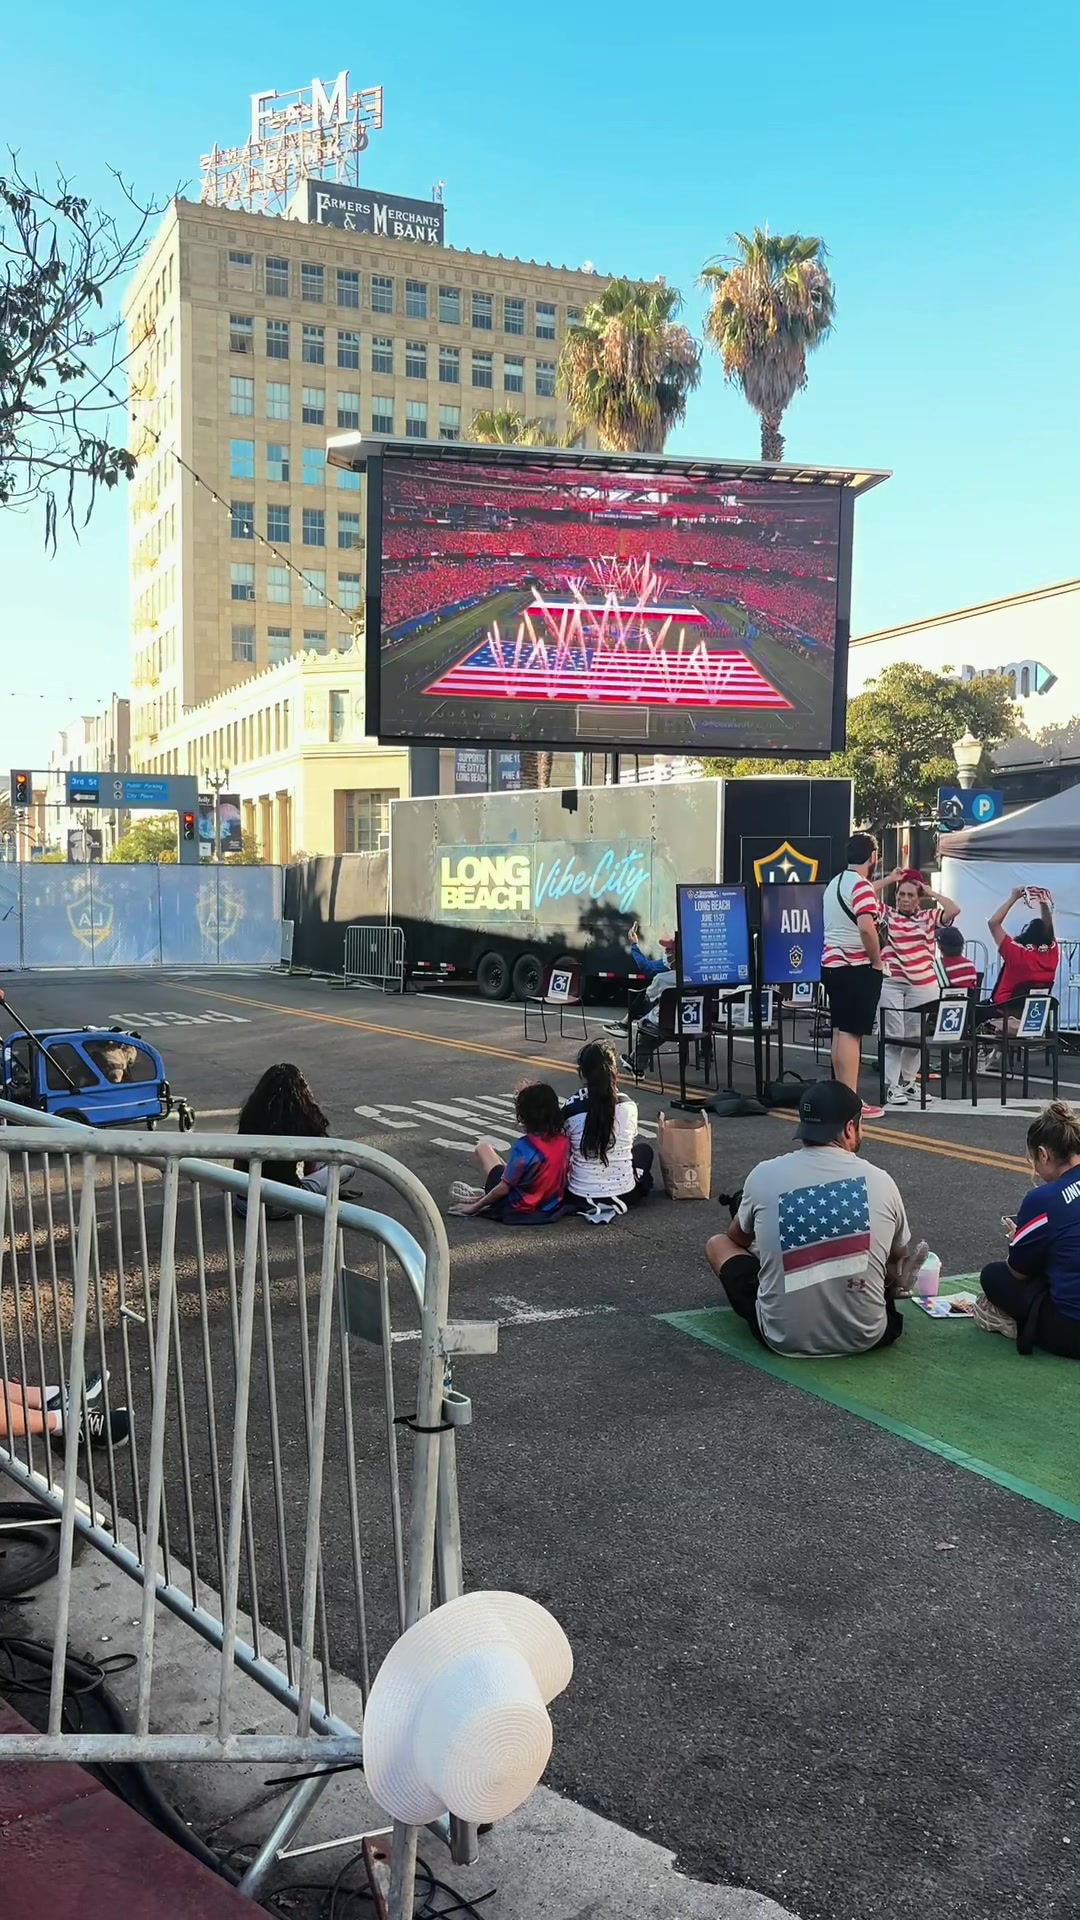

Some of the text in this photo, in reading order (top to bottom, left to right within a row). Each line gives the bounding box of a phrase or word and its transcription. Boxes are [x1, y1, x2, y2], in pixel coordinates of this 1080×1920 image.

[394, 222, 439, 243] BANK
[458, 752, 486, 763] SUPPORTS
[500, 754, 513, 763] JUNE
[456, 763, 467, 772] THE
[467, 763, 480, 772] CITY
[455, 773, 488, 783] LONG BEACH
[501, 771, 515, 780] PINE
[71, 778, 97, 786] 3rd St
[978, 798, 991, 817] P
[440, 849, 650, 915] LONG Vibe City
[440, 885, 530, 911] BEACH
[694, 899, 731, 911] LONG BEACH
[700, 913, 713, 923] JUNE
[780, 909, 812, 934] ADA
